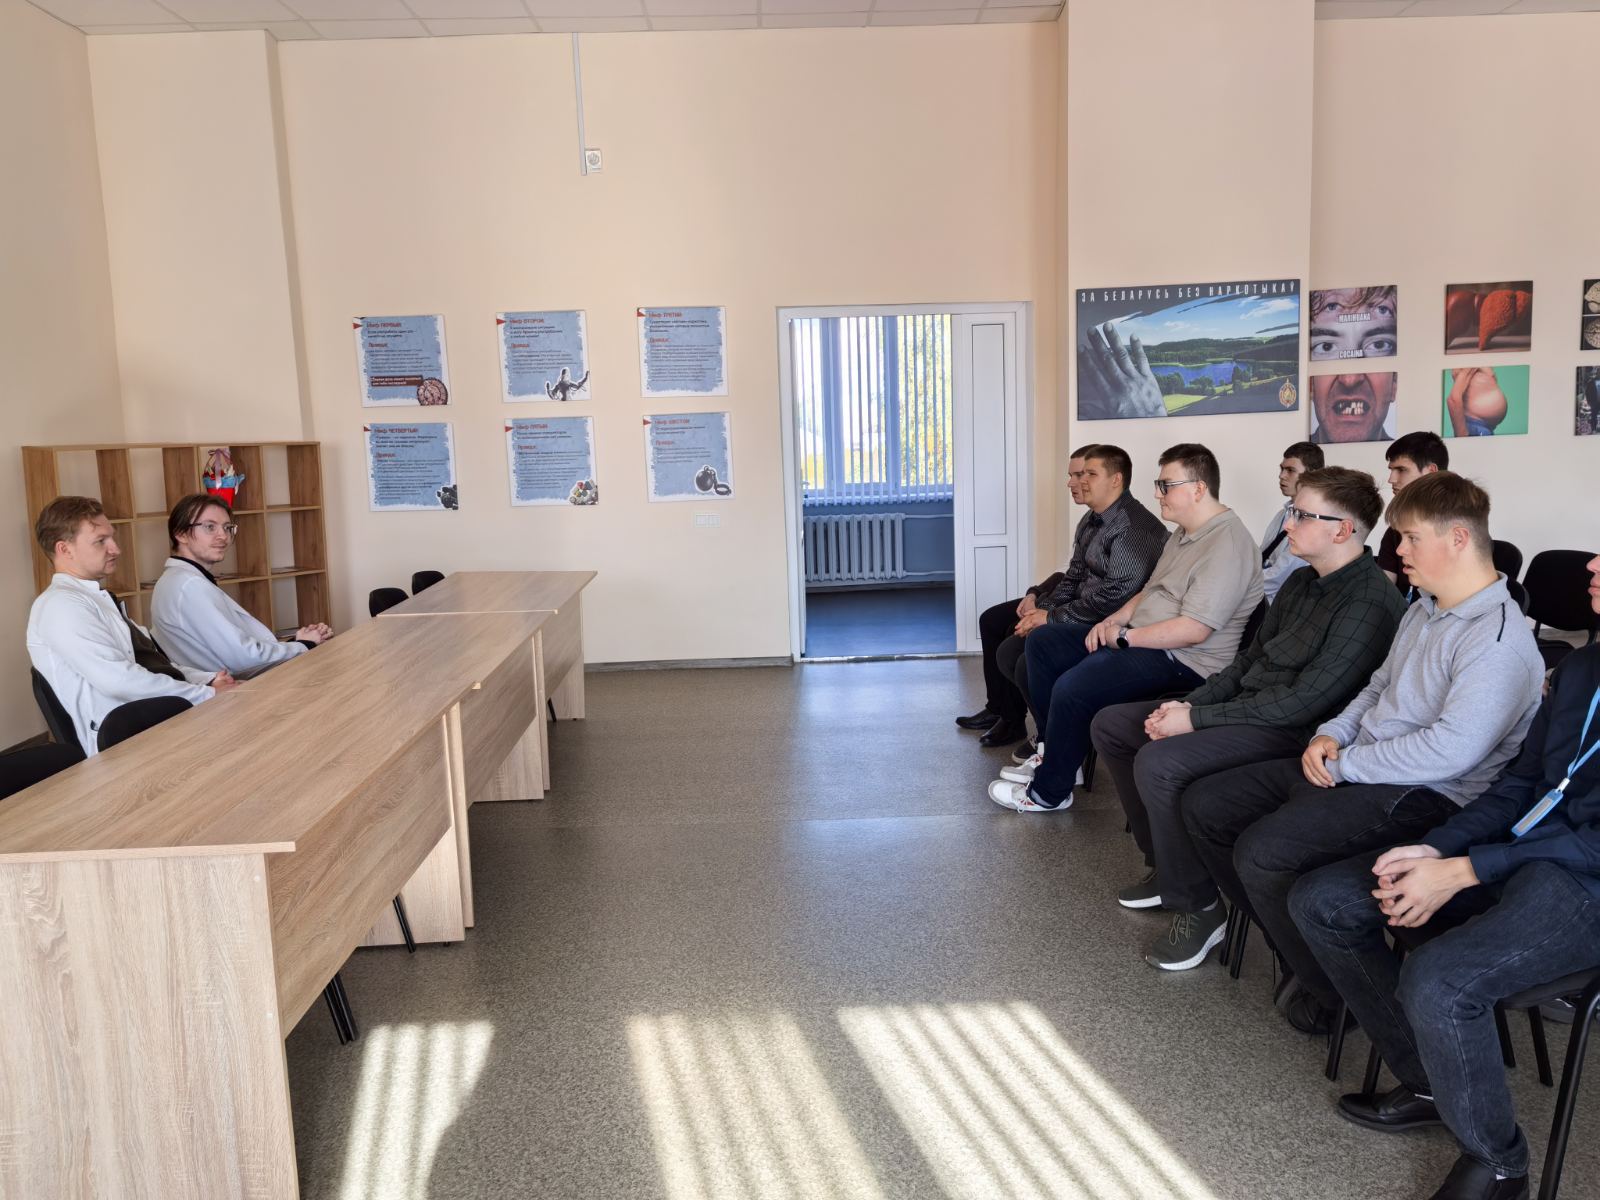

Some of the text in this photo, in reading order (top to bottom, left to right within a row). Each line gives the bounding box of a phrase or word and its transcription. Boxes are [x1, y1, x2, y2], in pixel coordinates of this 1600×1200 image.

[1081, 281, 1296, 303] ЗА БЕЛАРУСЬ БЕЗ НАРКОТЫКАЎ
